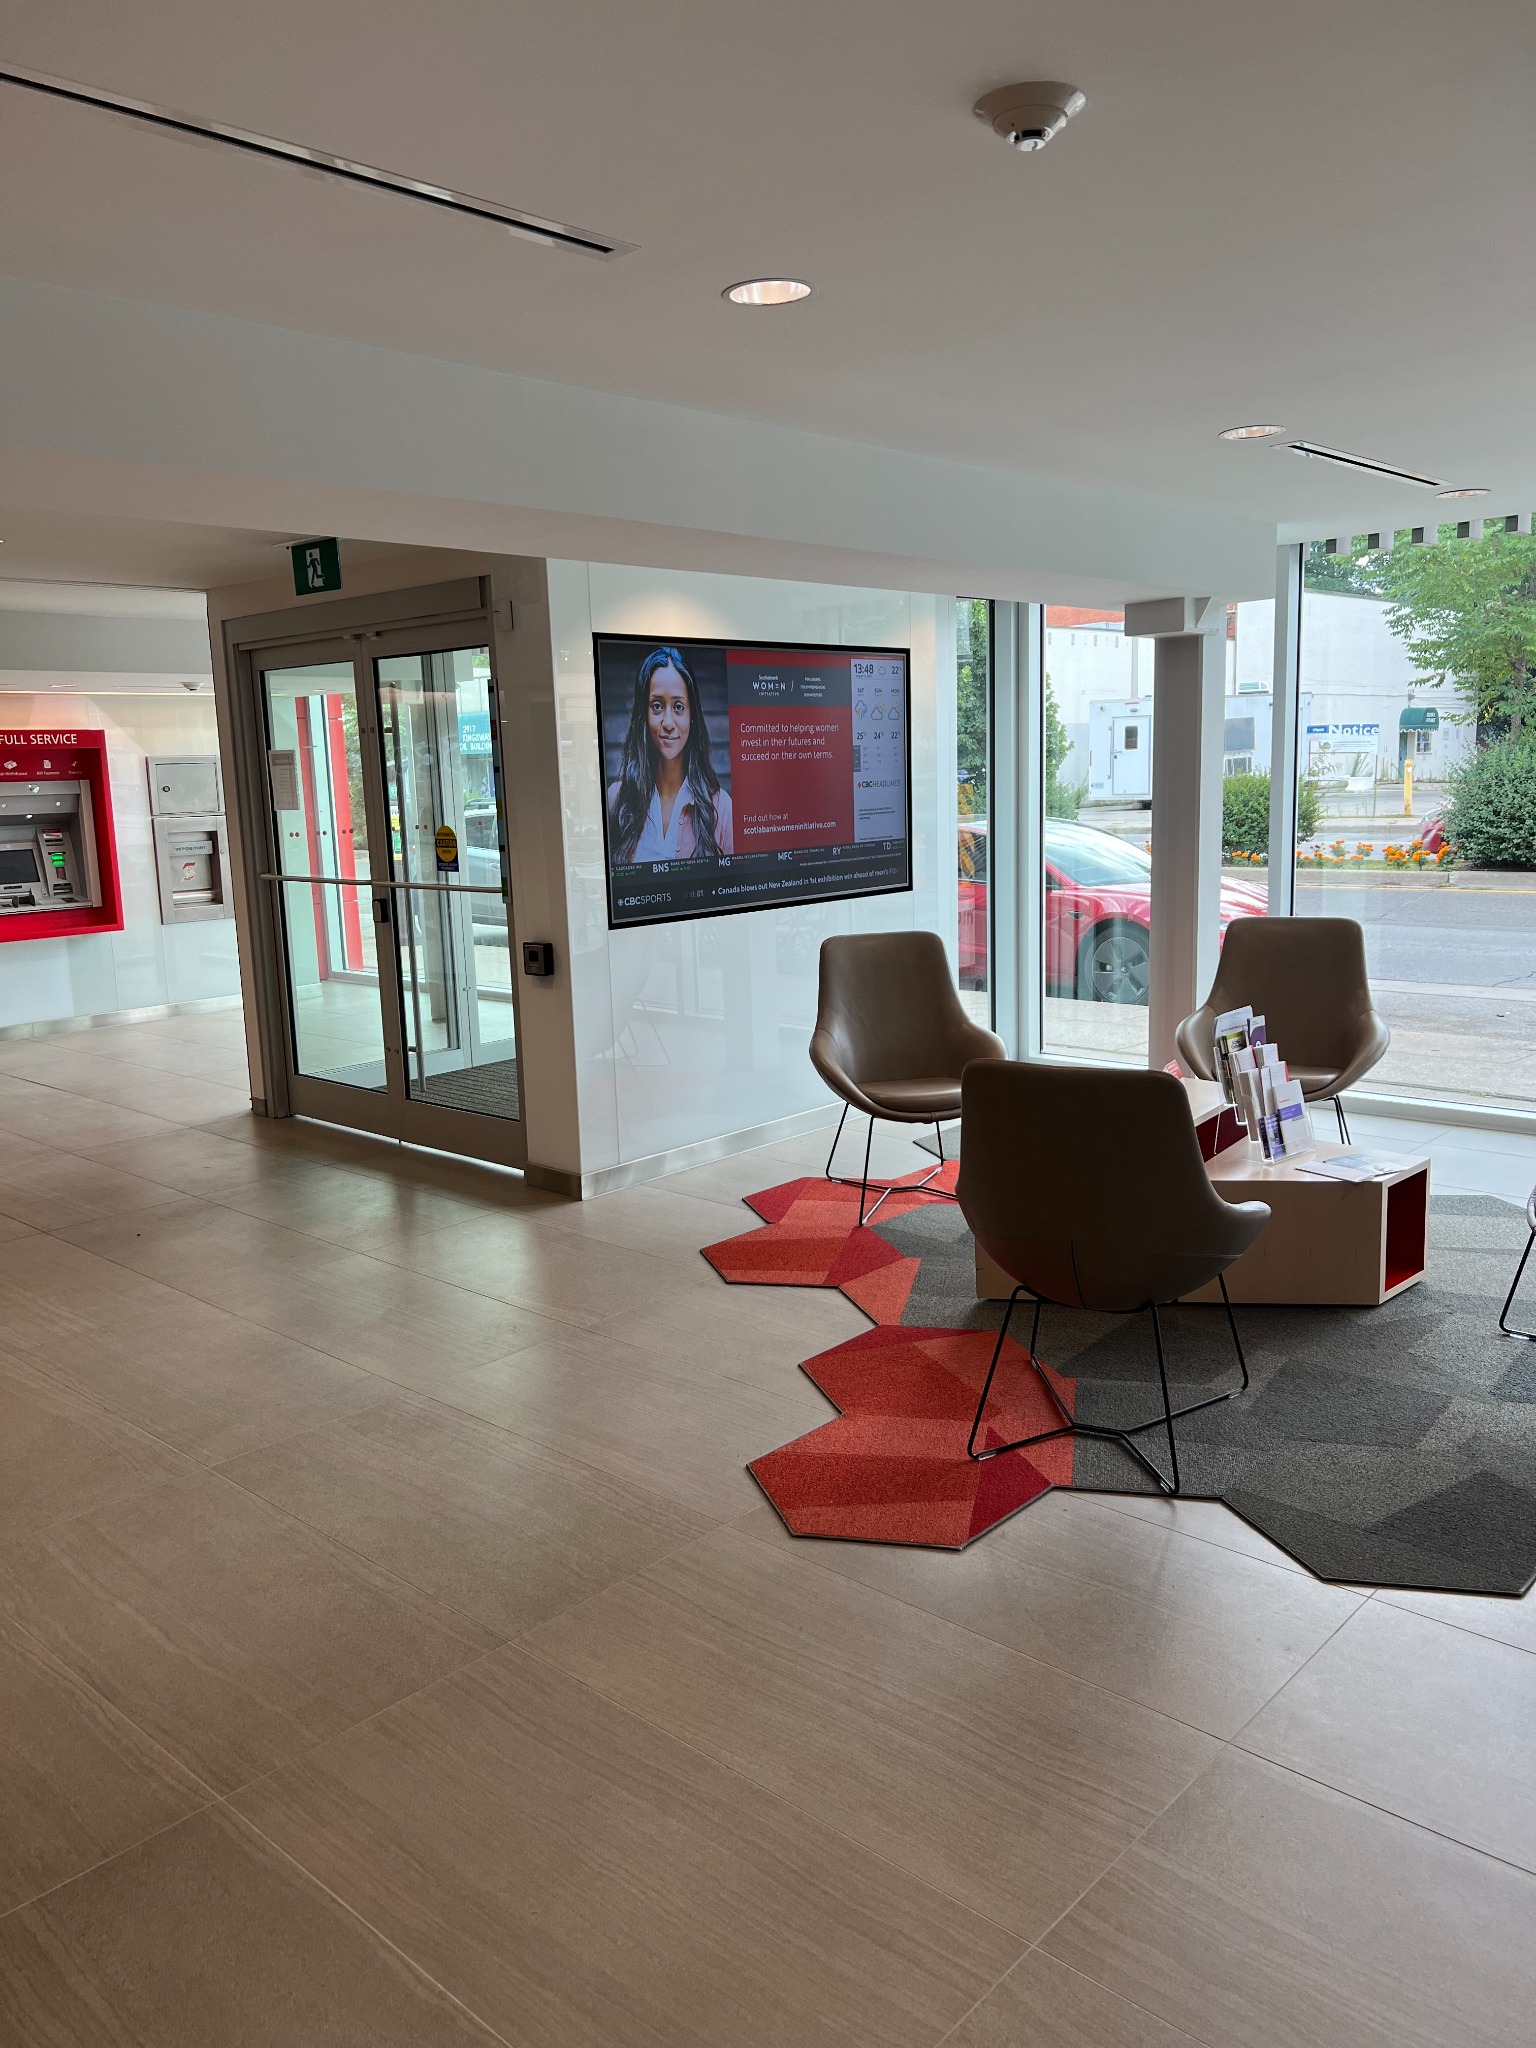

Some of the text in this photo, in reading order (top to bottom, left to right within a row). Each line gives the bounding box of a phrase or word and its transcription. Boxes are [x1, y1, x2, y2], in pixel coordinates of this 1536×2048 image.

[854, 664, 874, 674] 13:48
[463, 725, 476, 733] 2917
[740, 723, 839, 734] Committed to helping women
[1329, 724, 1379, 735] Notice
[30, 734, 77, 744] SERVICE
[741, 736, 825, 746] invest in their futures and
[742, 751, 769, 761] succeed
[782, 750, 797, 760] their
[744, 814, 757, 822] Find
[758, 814, 768, 822] out
[744, 821, 836, 834] scotiabankwomeninitiative.com
[833, 847, 841, 855] RY
[883, 842, 891, 850] TD
[778, 852, 792, 860] MFC
[719, 857, 730, 867] MG
[653, 863, 669, 873] BNS
[718, 886, 740, 895] Canada
[741, 884, 757, 892] blows
[782, 878, 802, 888] Zealand
[818, 874, 843, 883] exhibition
